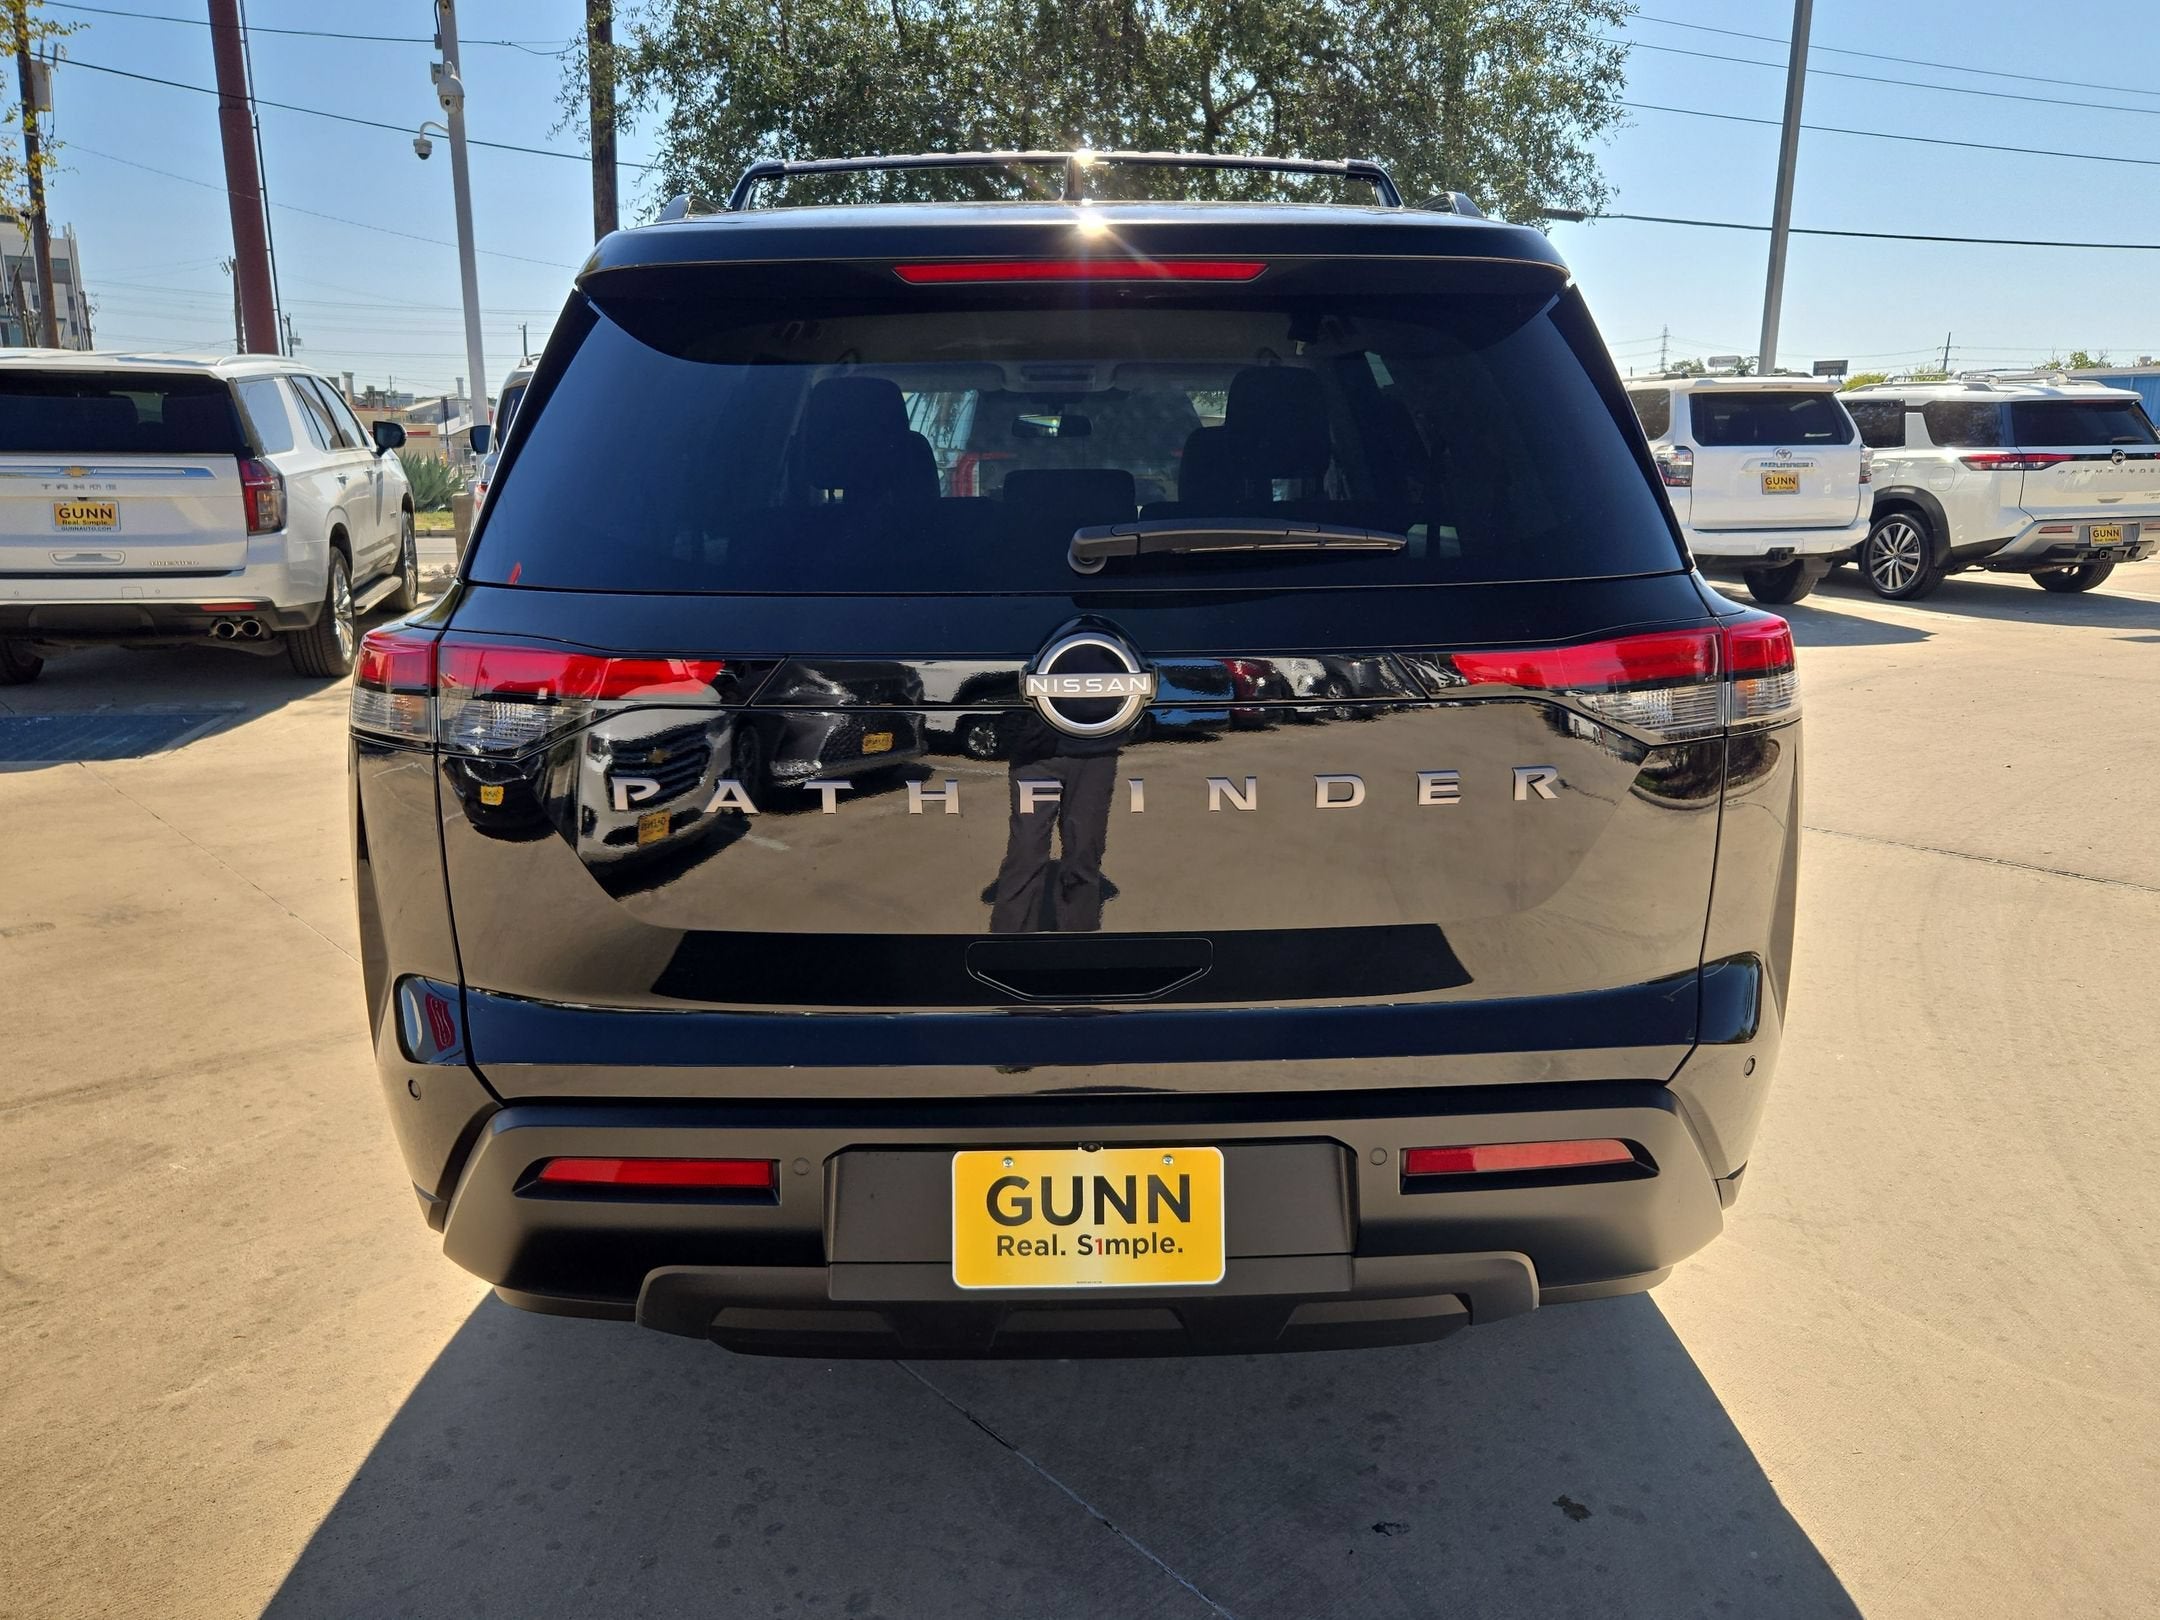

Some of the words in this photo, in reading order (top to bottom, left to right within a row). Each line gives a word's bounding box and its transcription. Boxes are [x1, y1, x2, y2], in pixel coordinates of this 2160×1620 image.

[1765, 477, 1796, 485] GUNN
[58, 507, 113, 519] GUNN
[2093, 529, 2119, 538] GUNN
[1029, 677, 1148, 693] NISSAN
[610, 765, 1560, 816] PATHFINDER
[985, 1173, 1192, 1227] GUNN
[996, 1233, 1067, 1257] Real.
